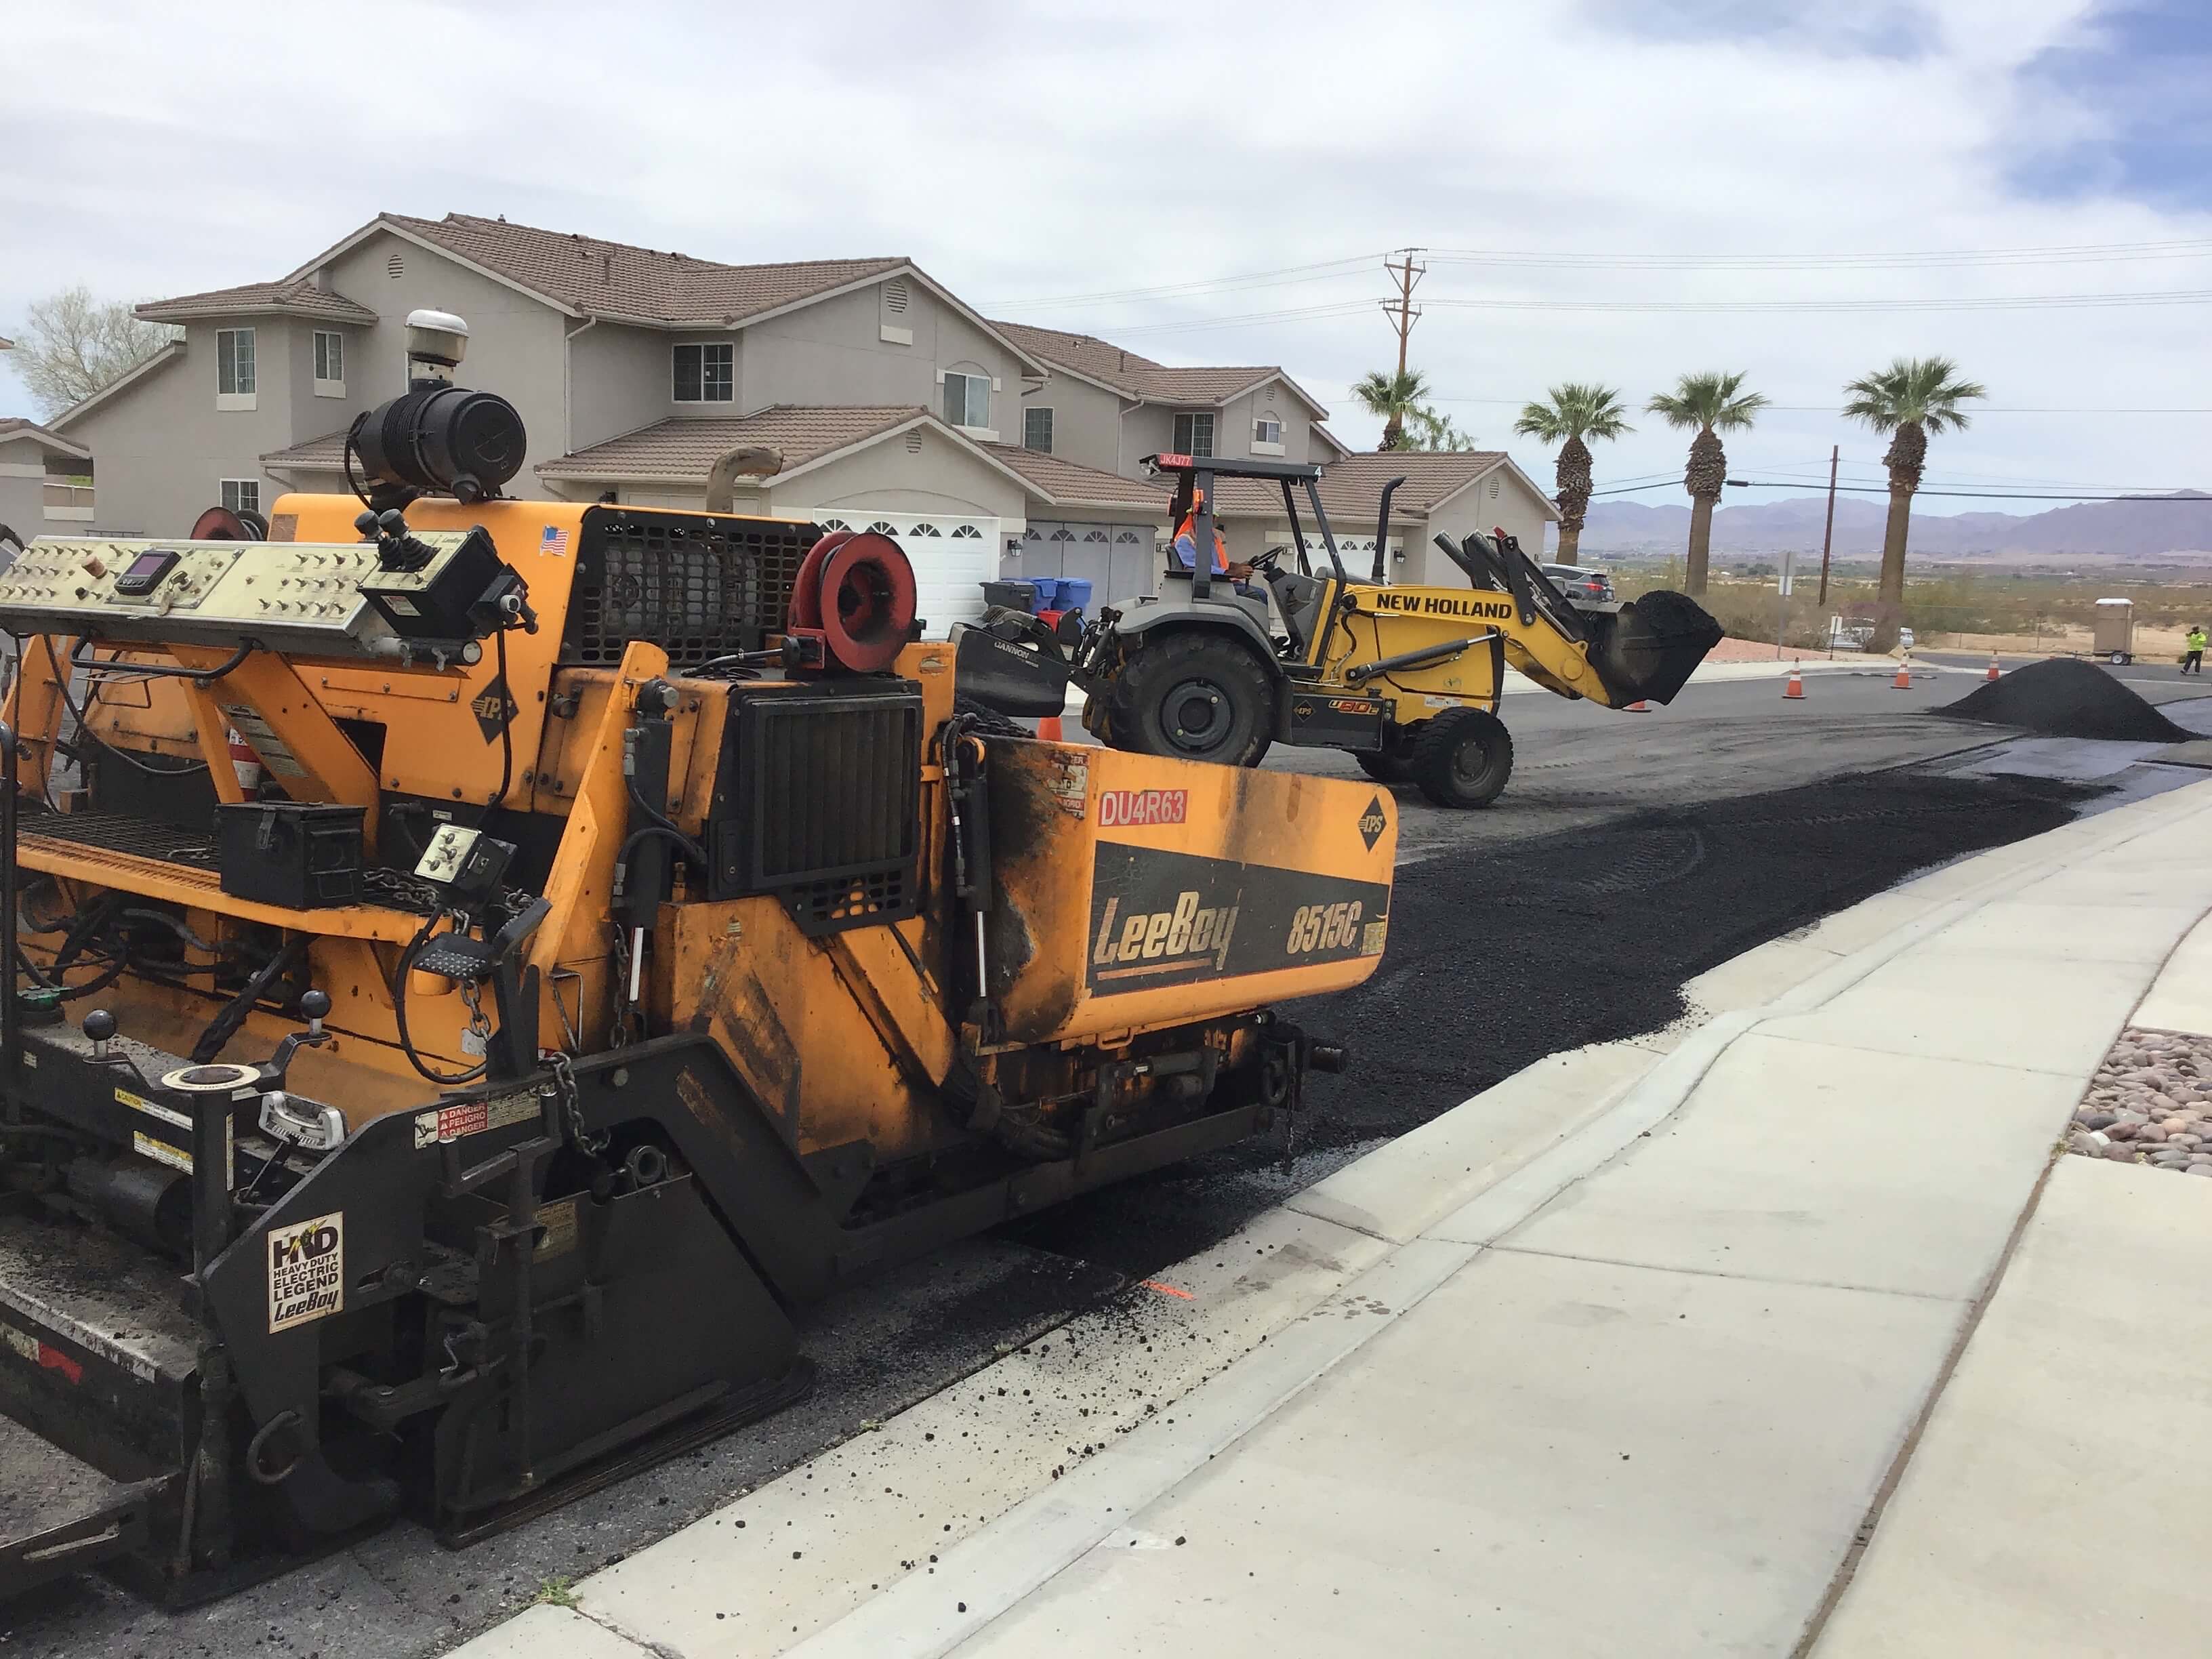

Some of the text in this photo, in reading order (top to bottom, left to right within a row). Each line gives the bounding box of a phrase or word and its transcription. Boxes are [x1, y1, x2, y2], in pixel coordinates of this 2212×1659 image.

[1160, 455, 1191, 466] JK4J77
[1315, 466, 1322, 476] 4
[1376, 594, 1513, 619] NEW HOLLAND
[1101, 791, 1185, 825] DU4R63
[1364, 815, 1383, 833] IPS
[1093, 888, 1243, 971] LeeBoy
[1286, 900, 1363, 955] 8515C
[449, 1103, 486, 1119] DANGER
[449, 1111, 486, 1128] PELIGRO
[449, 1121, 486, 1139] DANGER
[274, 1252, 338, 1279] HEAVY DUTY
[274, 1261, 339, 1290] ELECTRIC
[274, 1273, 339, 1303] LEGEND
[274, 1289, 340, 1323] LeeBoy
